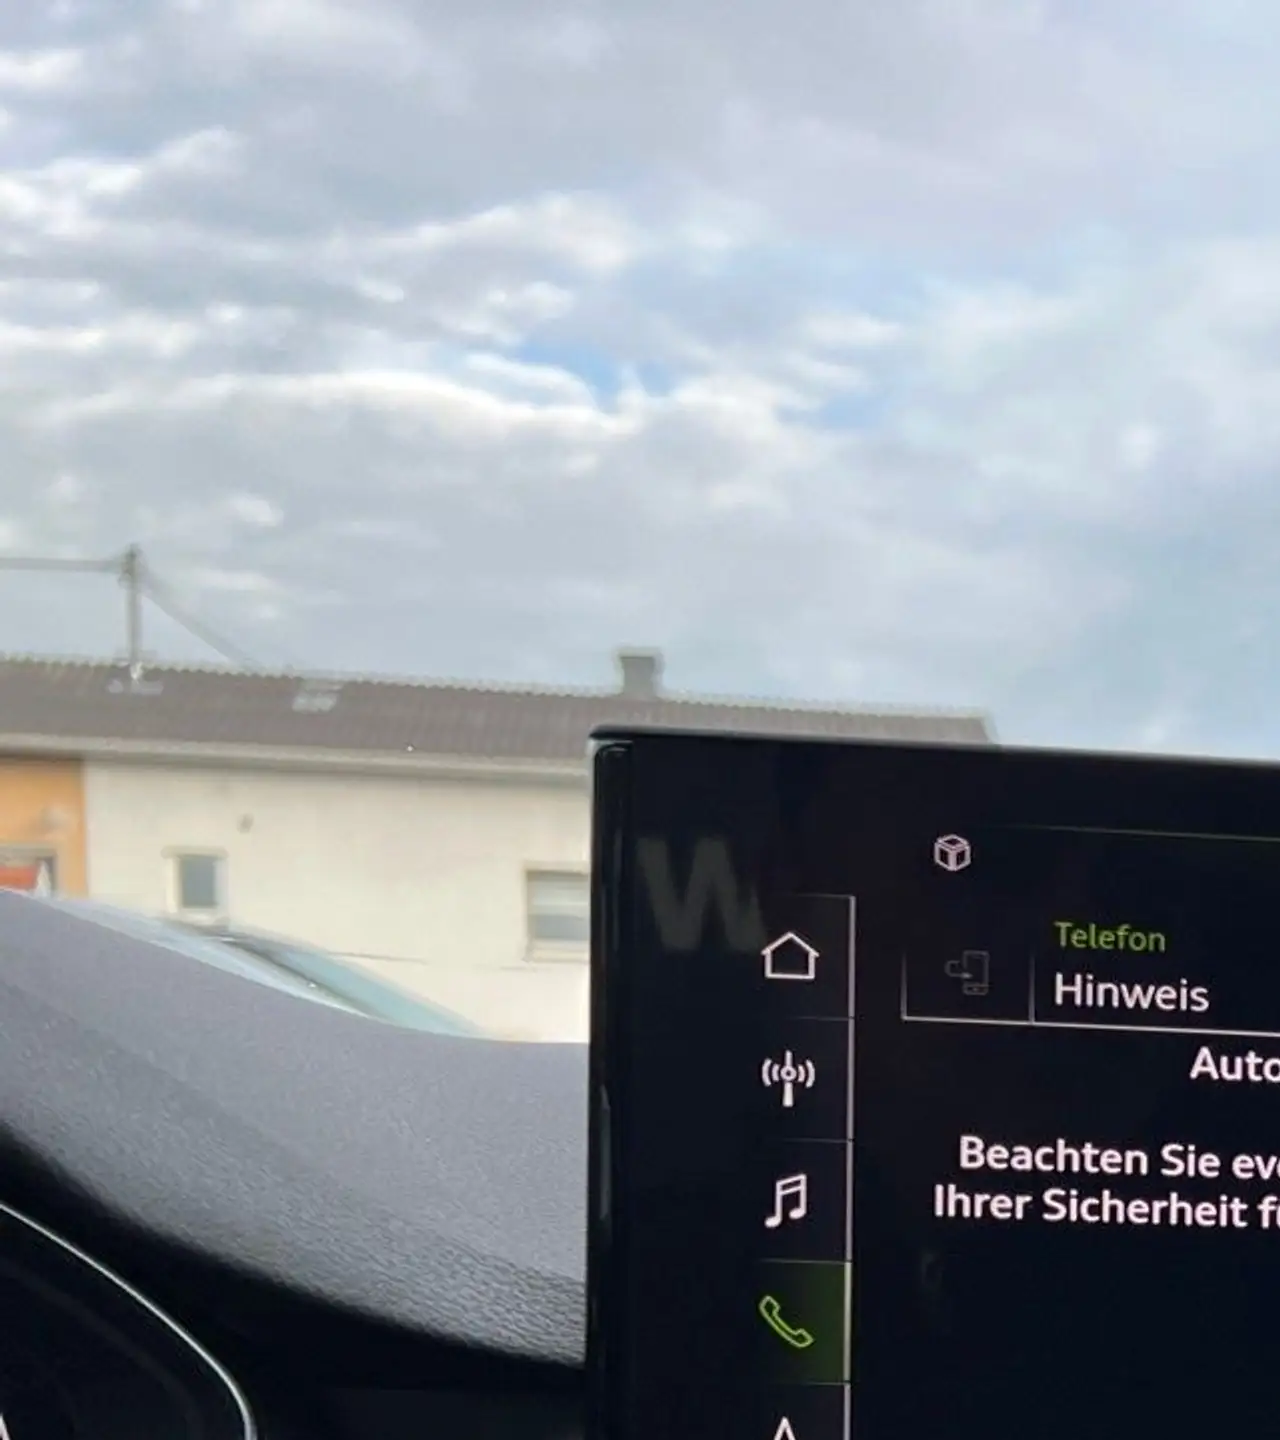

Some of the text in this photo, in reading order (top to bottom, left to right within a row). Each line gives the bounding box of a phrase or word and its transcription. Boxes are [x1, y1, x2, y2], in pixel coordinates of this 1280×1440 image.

[1055, 921, 1166, 952] Telefon
[1055, 972, 1210, 1012] Hinweis
[959, 1134, 1148, 1177] Beachten
[1160, 1142, 1221, 1179] Sie
[934, 1182, 1033, 1221] Ihrer
[1042, 1187, 1249, 1229] Sicherheit
